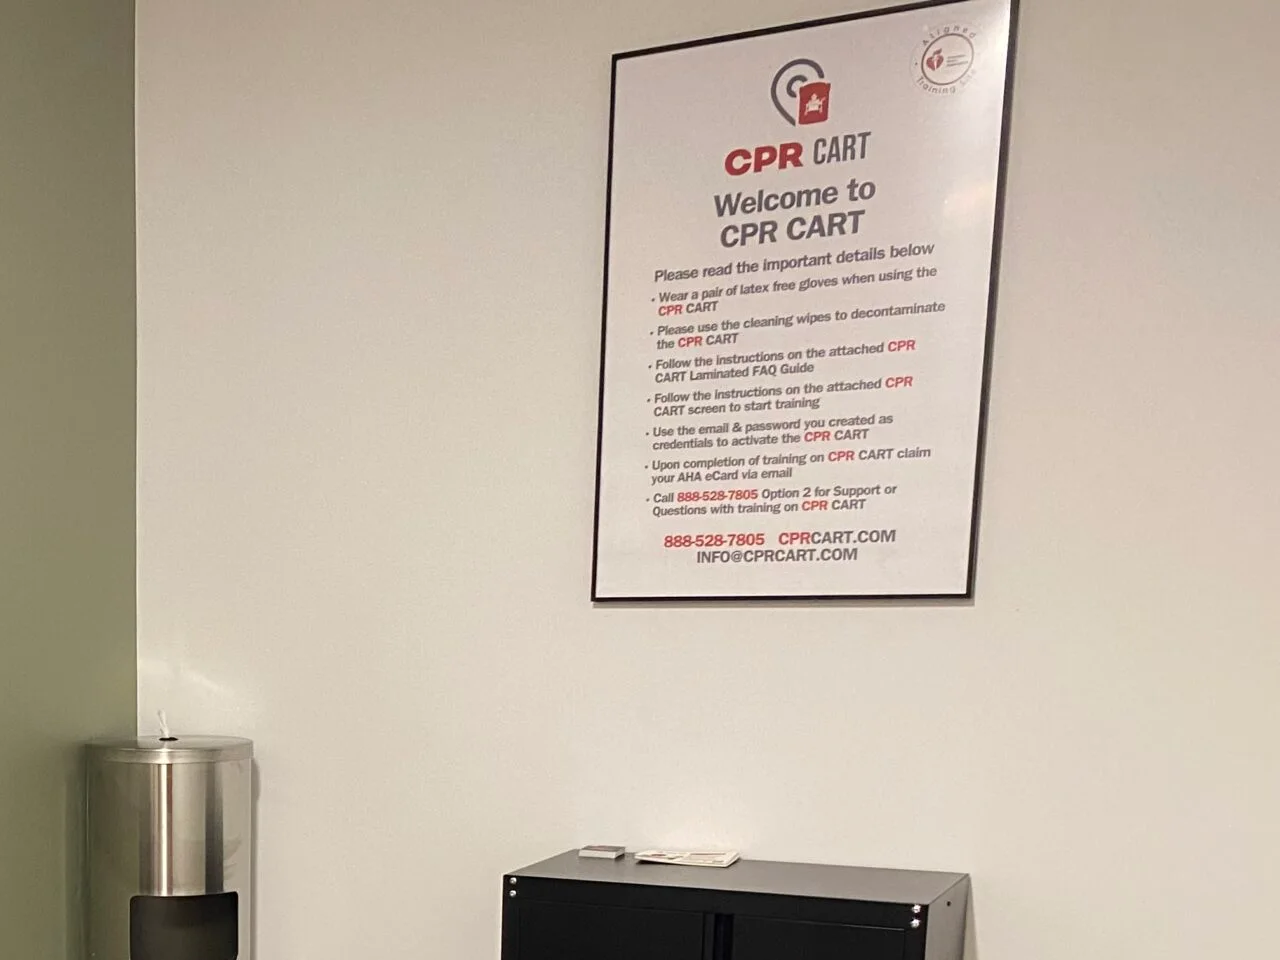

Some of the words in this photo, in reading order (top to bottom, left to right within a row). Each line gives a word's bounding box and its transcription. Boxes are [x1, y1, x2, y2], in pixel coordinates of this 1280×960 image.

[724, 142, 803, 176] CPR
[813, 131, 871, 165] CART
[714, 185, 838, 217] Welcome
[846, 178, 876, 201] to
[720, 220, 778, 248] CPR
[786, 209, 865, 240] CART
[654, 268, 699, 283] Please
[702, 262, 733, 277] read
[735, 260, 759, 274] the
[762, 252, 832, 271] important
[835, 246, 885, 264] details
[890, 243, 935, 258] below
[658, 291, 689, 303] Wear
[690, 291, 699, 300] a
[701, 286, 724, 301] pair
[725, 284, 738, 296] of
[739, 283, 770, 295] latex
[772, 280, 796, 292] free
[798, 277, 838, 292] gloves
[841, 272, 875, 285] when
[878, 268, 914, 281] using
[916, 266, 937, 278] the
[657, 325, 695, 336] Please
[697, 323, 718, 333] use
[720, 319, 740, 331] the
[743, 314, 794, 328] cleaning
[796, 312, 831, 325] wipes
[834, 310, 848, 320] to
[850, 301, 945, 319] decontaminate
[658, 304, 683, 316] CPR
[685, 300, 719, 314] CART
[656, 339, 675, 349] the
[677, 335, 703, 348] CPR
[705, 332, 739, 346] CART
[655, 358, 692, 370] Follow
[694, 356, 713, 368] the
[716, 351, 784, 365] instructions
[787, 351, 802, 360] on
[805, 347, 826, 359] the
[828, 341, 884, 357] attached
[887, 339, 915, 352] CPR
[654, 370, 688, 384] CART
[689, 366, 749, 381] Laminated
[752, 364, 777, 376] FAQ
[779, 362, 814, 374] Guide
[652, 426, 674, 437] Use
[676, 425, 696, 436] the
[698, 422, 729, 434] email
[731, 422, 743, 432] &
[744, 418, 801, 434] password
[804, 419, 825, 431] you
[828, 413, 875, 427] created
[878, 415, 893, 424] as
[652, 437, 713, 450] credentials
[716, 437, 728, 447] to
[731, 434, 778, 446] activate
[781, 433, 801, 443] the
[804, 430, 831, 442] CPR
[833, 428, 870, 440] CART
[652, 460, 680, 472] Upon
[682, 456, 745, 470] completion
[748, 454, 760, 466] of
[762, 453, 807, 465] training
[809, 454, 824, 462] on
[827, 450, 855, 462] CPR
[858, 448, 895, 460] CART
[896, 446, 931, 458] claim
[651, 474, 675, 485] your
[676, 471, 702, 482] AHA
[704, 469, 739, 481] eCard
[741, 468, 758, 479] via
[760, 467, 792, 479] email
[653, 492, 674, 503] Call
[677, 488, 759, 502] 888-528-7805
[761, 488, 799, 501] Option
[802, 486, 811, 497] 2
[814, 486, 831, 497] for
[833, 484, 881, 498] Support
[884, 486, 897, 494] or
[652, 505, 707, 518] Questions
[710, 503, 734, 514] with
[737, 502, 781, 514] training
[783, 503, 798, 512] on
[801, 500, 829, 511] CPR
[831, 498, 867, 510] CART
[664, 533, 765, 548] 888-528-7805
[778, 529, 896, 545] CPRCART.COM
[697, 547, 858, 563] INFO@CPRCART.COM
